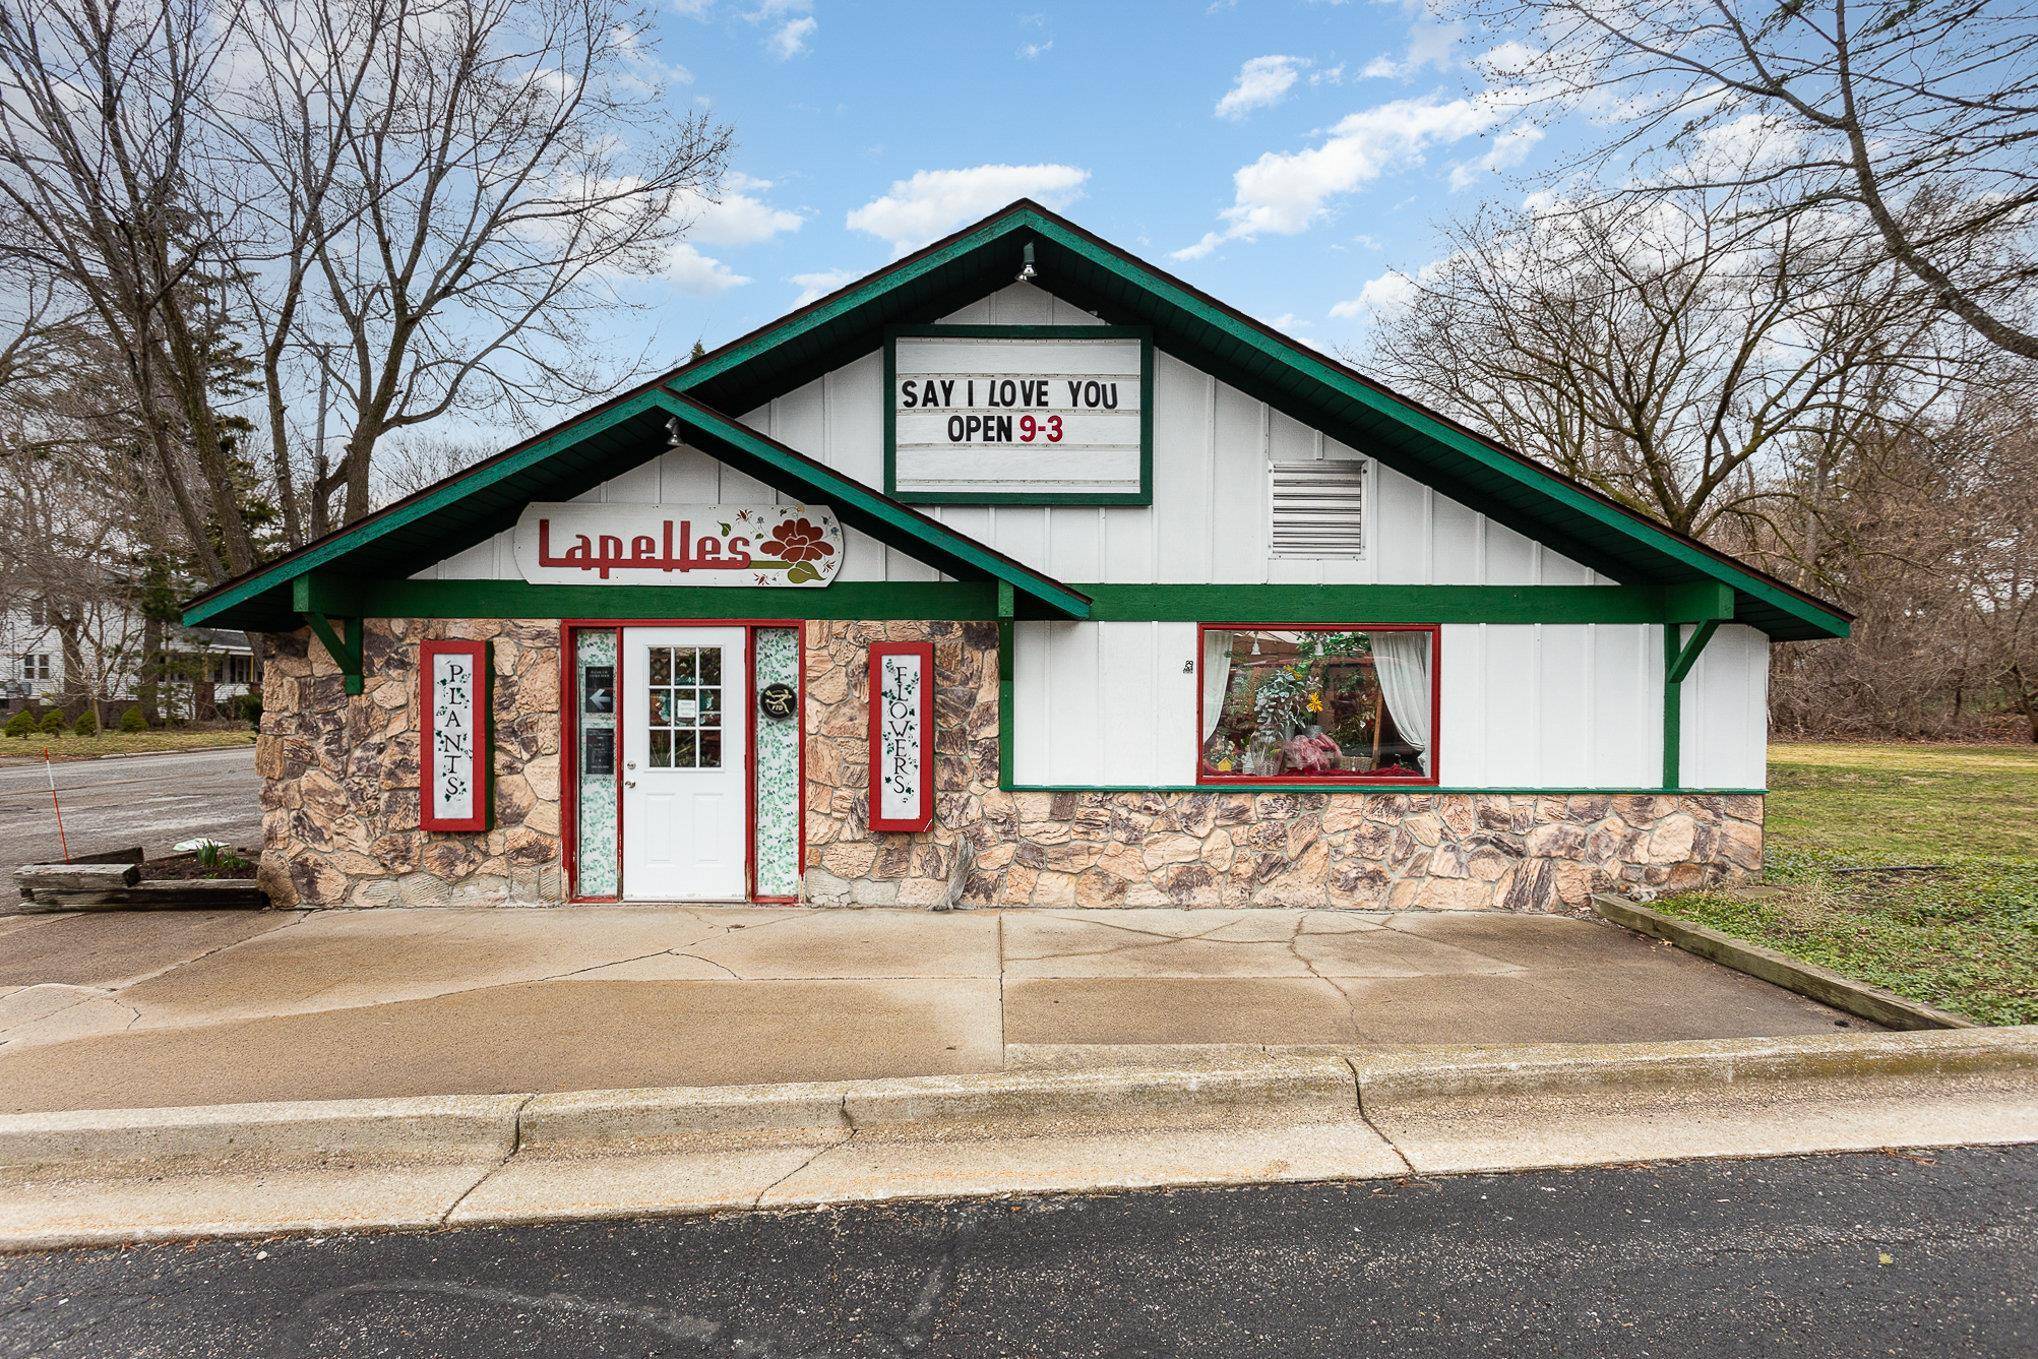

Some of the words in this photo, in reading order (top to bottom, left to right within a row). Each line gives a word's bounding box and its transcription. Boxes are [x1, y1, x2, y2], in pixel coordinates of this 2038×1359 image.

[902, 380, 955, 407] SAY
[967, 381, 974, 407] I
[988, 380, 1049, 407] LOVE
[1067, 381, 1118, 409] YOU
[948, 415, 1013, 442] OPEN
[1019, 415, 1063, 442] 9-3
[444, 664, 464, 795] PLANTS
[888, 666, 910, 794] FLOWERS
